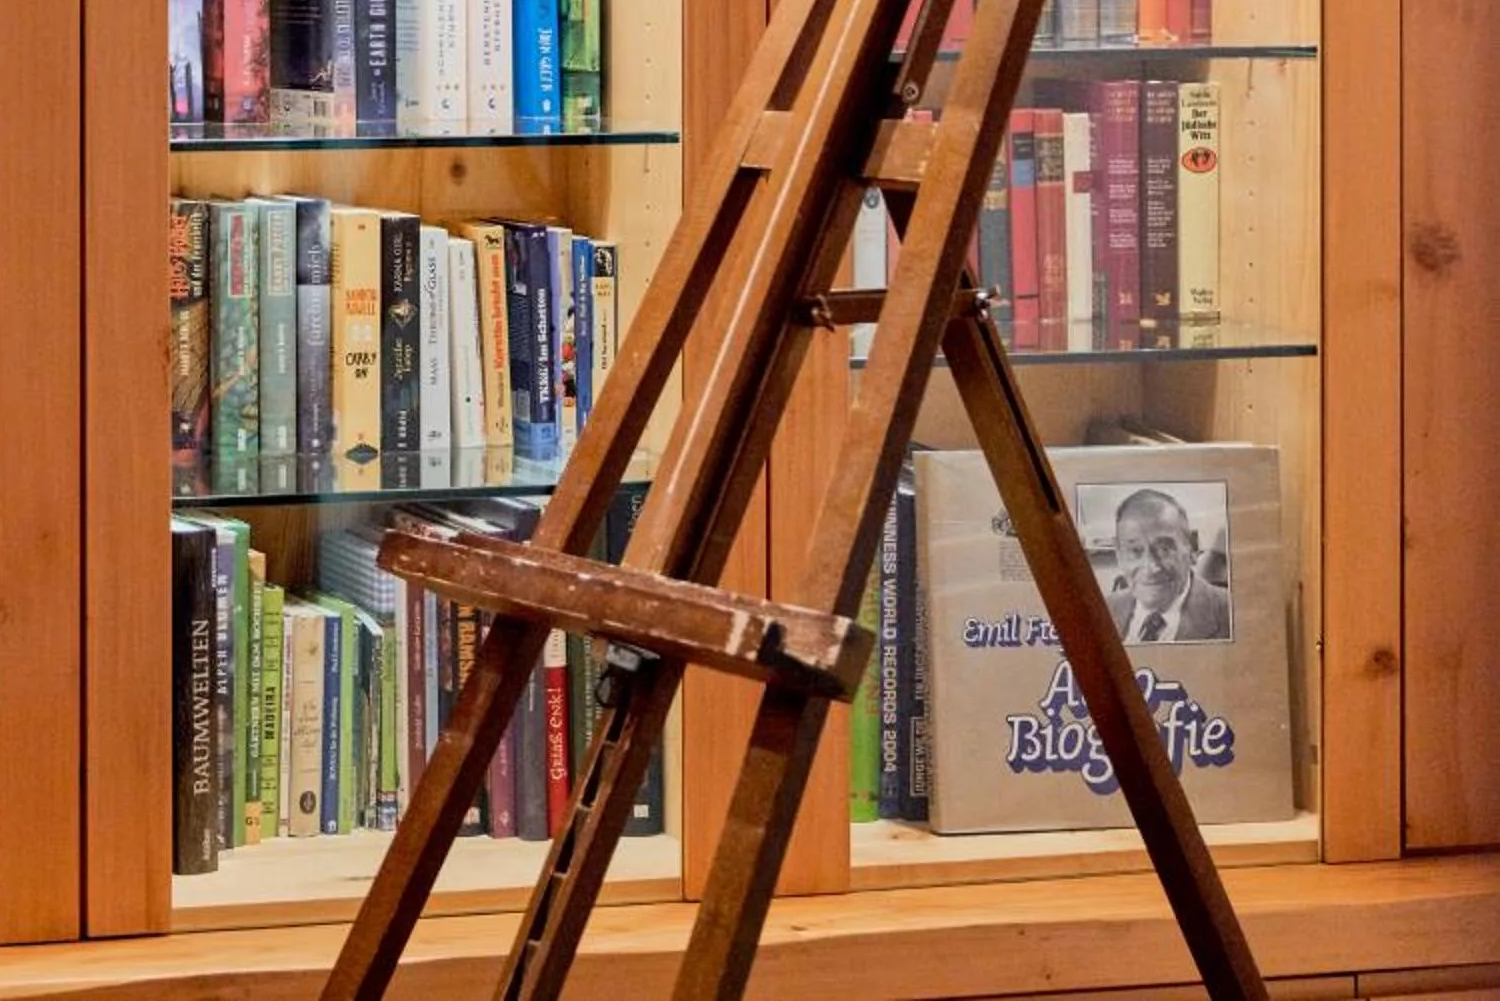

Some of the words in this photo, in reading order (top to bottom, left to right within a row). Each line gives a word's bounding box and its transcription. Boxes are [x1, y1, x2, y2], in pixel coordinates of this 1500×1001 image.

[368, 23, 387, 67] EARTH
[1191, 108, 1208, 119] Der
[306, 244, 321, 283] mich
[536, 288, 548, 343] Schatten
[882, 578, 898, 639] WORLD
[963, 613, 1022, 647] Emil
[1026, 615, 1064, 647] Fre
[191, 617, 211, 797] BAUMWELTEN
[882, 645, 898, 725] RECORDS
[263, 686, 277, 741] MADEIRA
[882, 729, 898, 772] 2004
[1005, 699, 1236, 795] Biogfie
